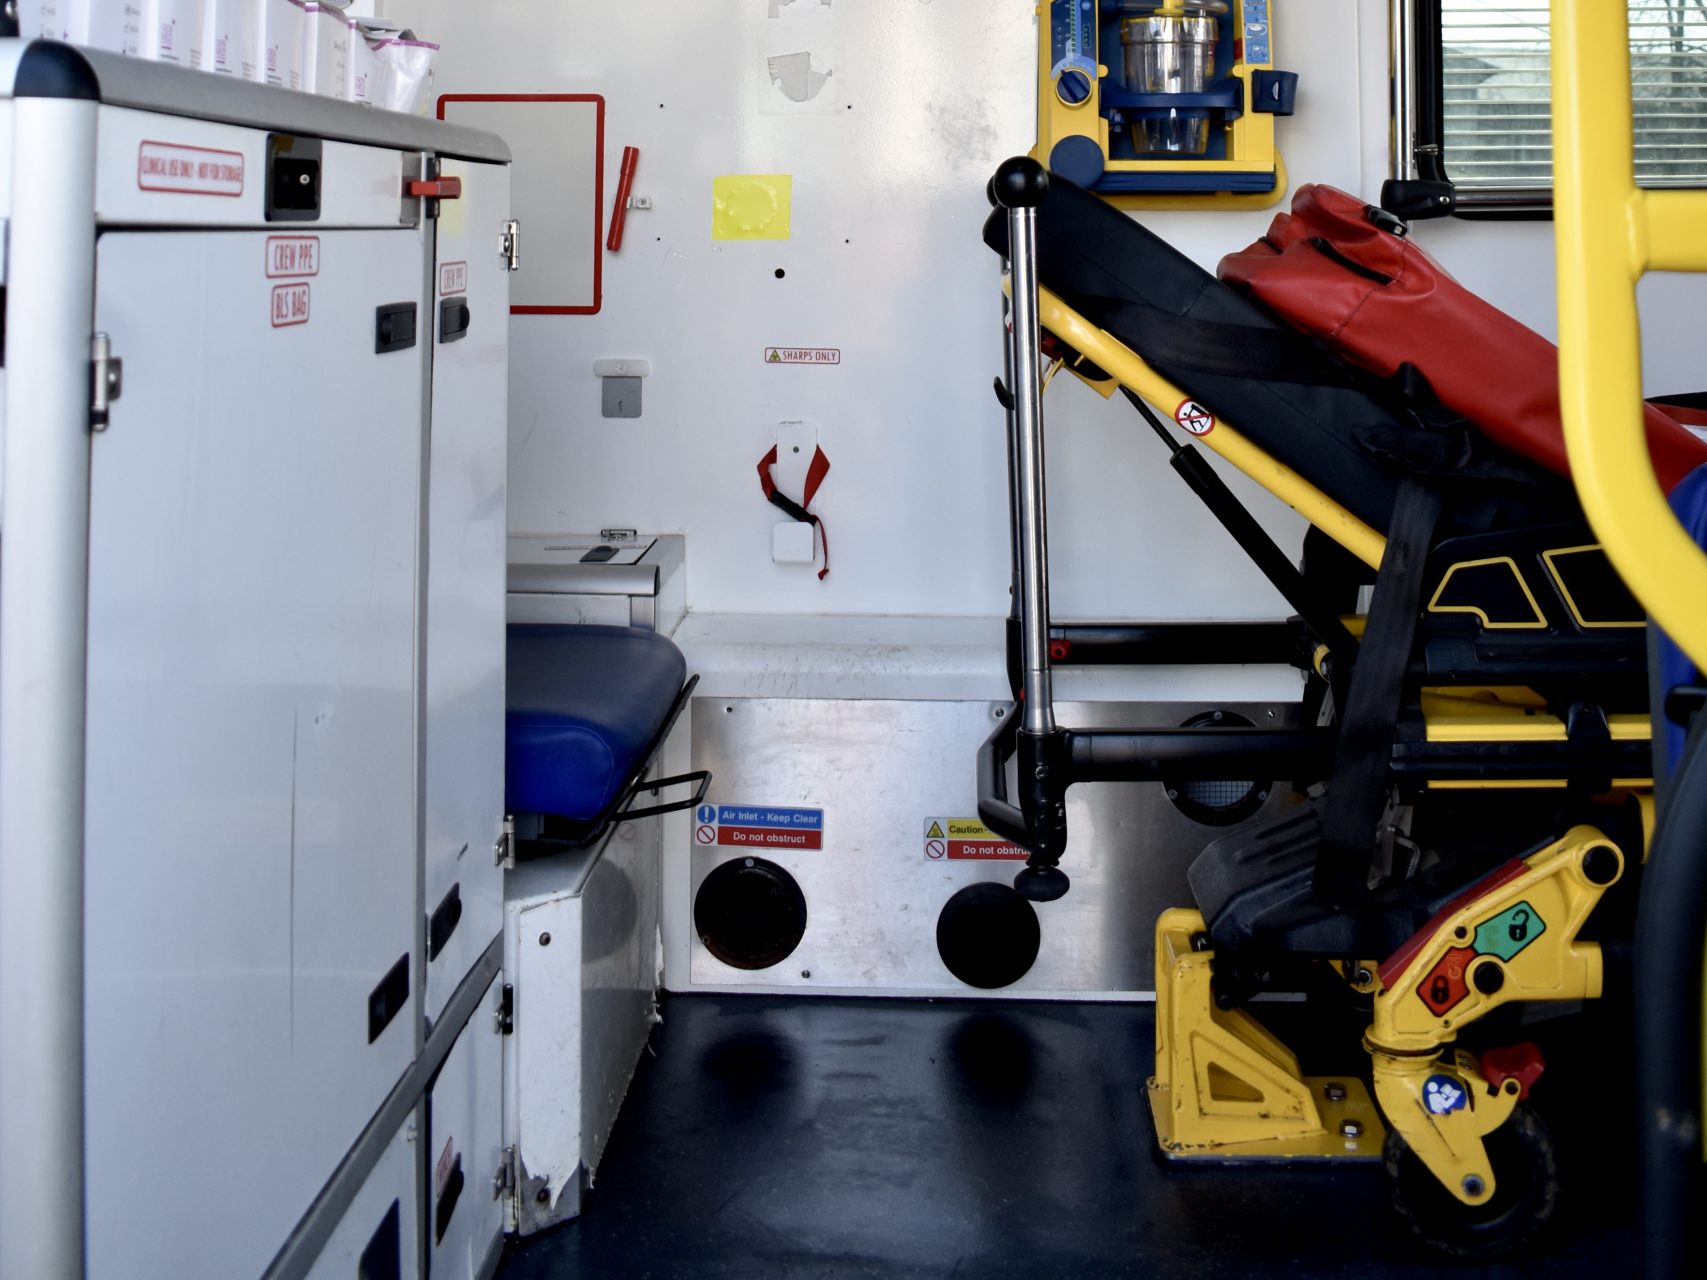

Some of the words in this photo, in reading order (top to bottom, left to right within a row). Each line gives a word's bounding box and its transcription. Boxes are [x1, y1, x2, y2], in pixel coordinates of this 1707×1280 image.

[143, 156, 167, 176] CLINICAL
[180, 160, 194, 178] ONLY
[220, 164, 242, 182] STORAGE
[275, 244, 296, 270] CREW
[299, 244, 312, 270] PPE
[276, 292, 288, 318] BLS
[292, 290, 306, 317] BAG
[783, 350, 813, 360] SHARPS
[816, 351, 836, 361] ONLY
[722, 811, 735, 820] Air
[738, 812, 758, 820] Inlet
[767, 813, 790, 824] Keep
[793, 814, 818, 823] Clear
[733, 832, 746, 840] Do
[749, 833, 764, 841] not
[766, 834, 806, 844] obstruct
[963, 846, 976, 854] Do
[979, 846, 994, 854] not
